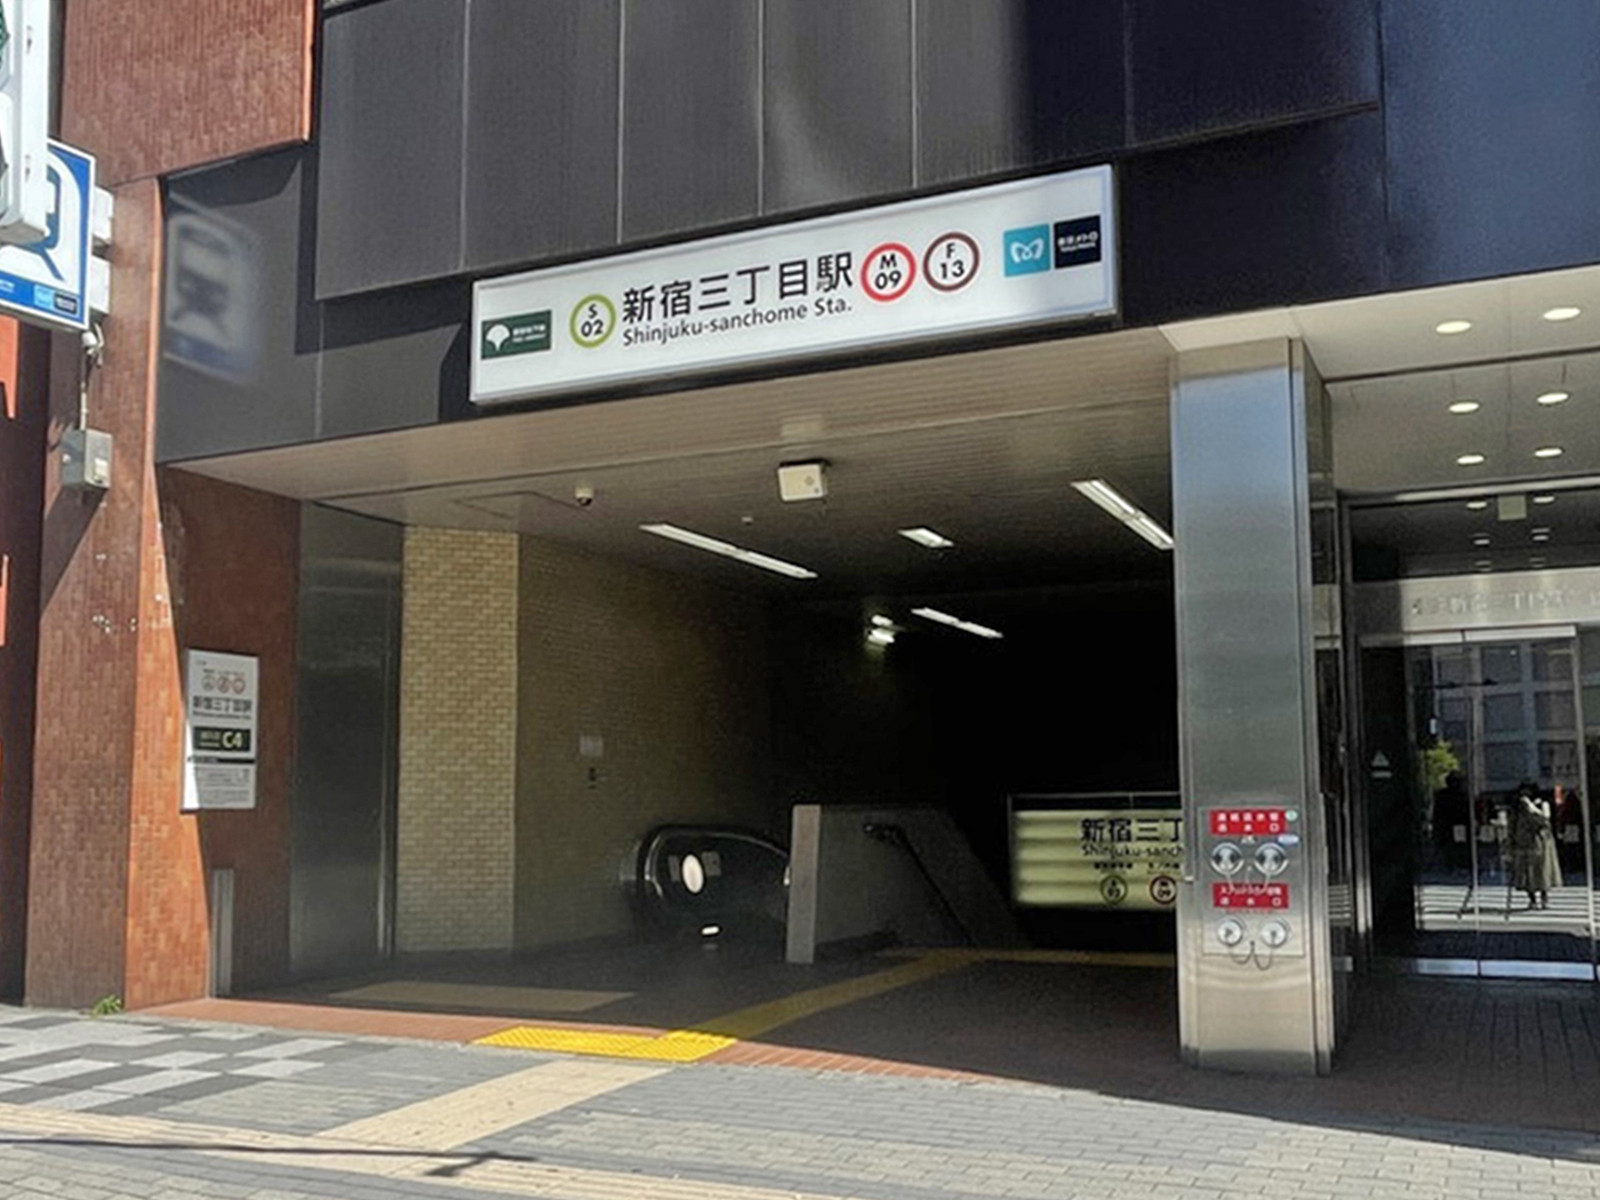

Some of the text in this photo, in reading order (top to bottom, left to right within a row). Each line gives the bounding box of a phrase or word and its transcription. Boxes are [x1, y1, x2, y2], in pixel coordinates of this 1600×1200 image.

[945, 243, 955, 258] F
[880, 253, 898, 269] M
[939, 259, 965, 280] 13
[622, 251, 853, 323] 新宿三丁目駅
[875, 270, 901, 291] 09
[588, 304, 598, 317] S
[581, 319, 604, 338] 02
[622, 295, 852, 347] Shinjuku-sanchome Sta.
[222, 731, 243, 748] C4
[1081, 818, 1182, 842] 新宿三丁
